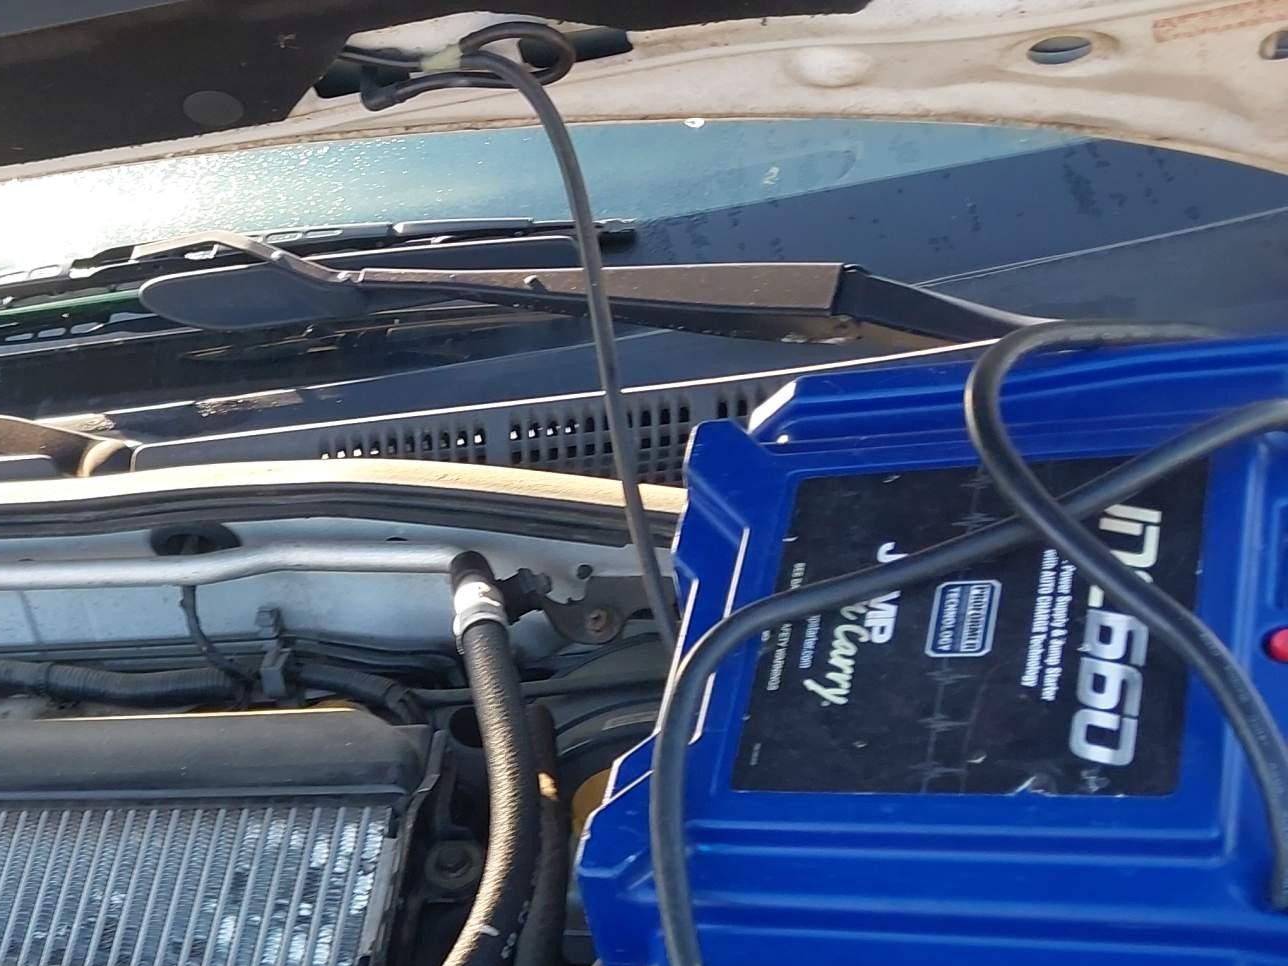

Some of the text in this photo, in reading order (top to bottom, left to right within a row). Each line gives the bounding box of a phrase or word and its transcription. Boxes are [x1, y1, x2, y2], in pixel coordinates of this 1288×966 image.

[864, 541, 910, 644] JMP
[936, 586, 961, 651] TECHNOLOGY
[962, 585, 986, 650] PROFORMER
[1020, 549, 1059, 687] with AUTO CHARGE Technology
[1040, 564, 1076, 701] Power Supply & Jump Starter
[766, 647, 789, 691] WARNINGS
[803, 623, 871, 705] Carry
